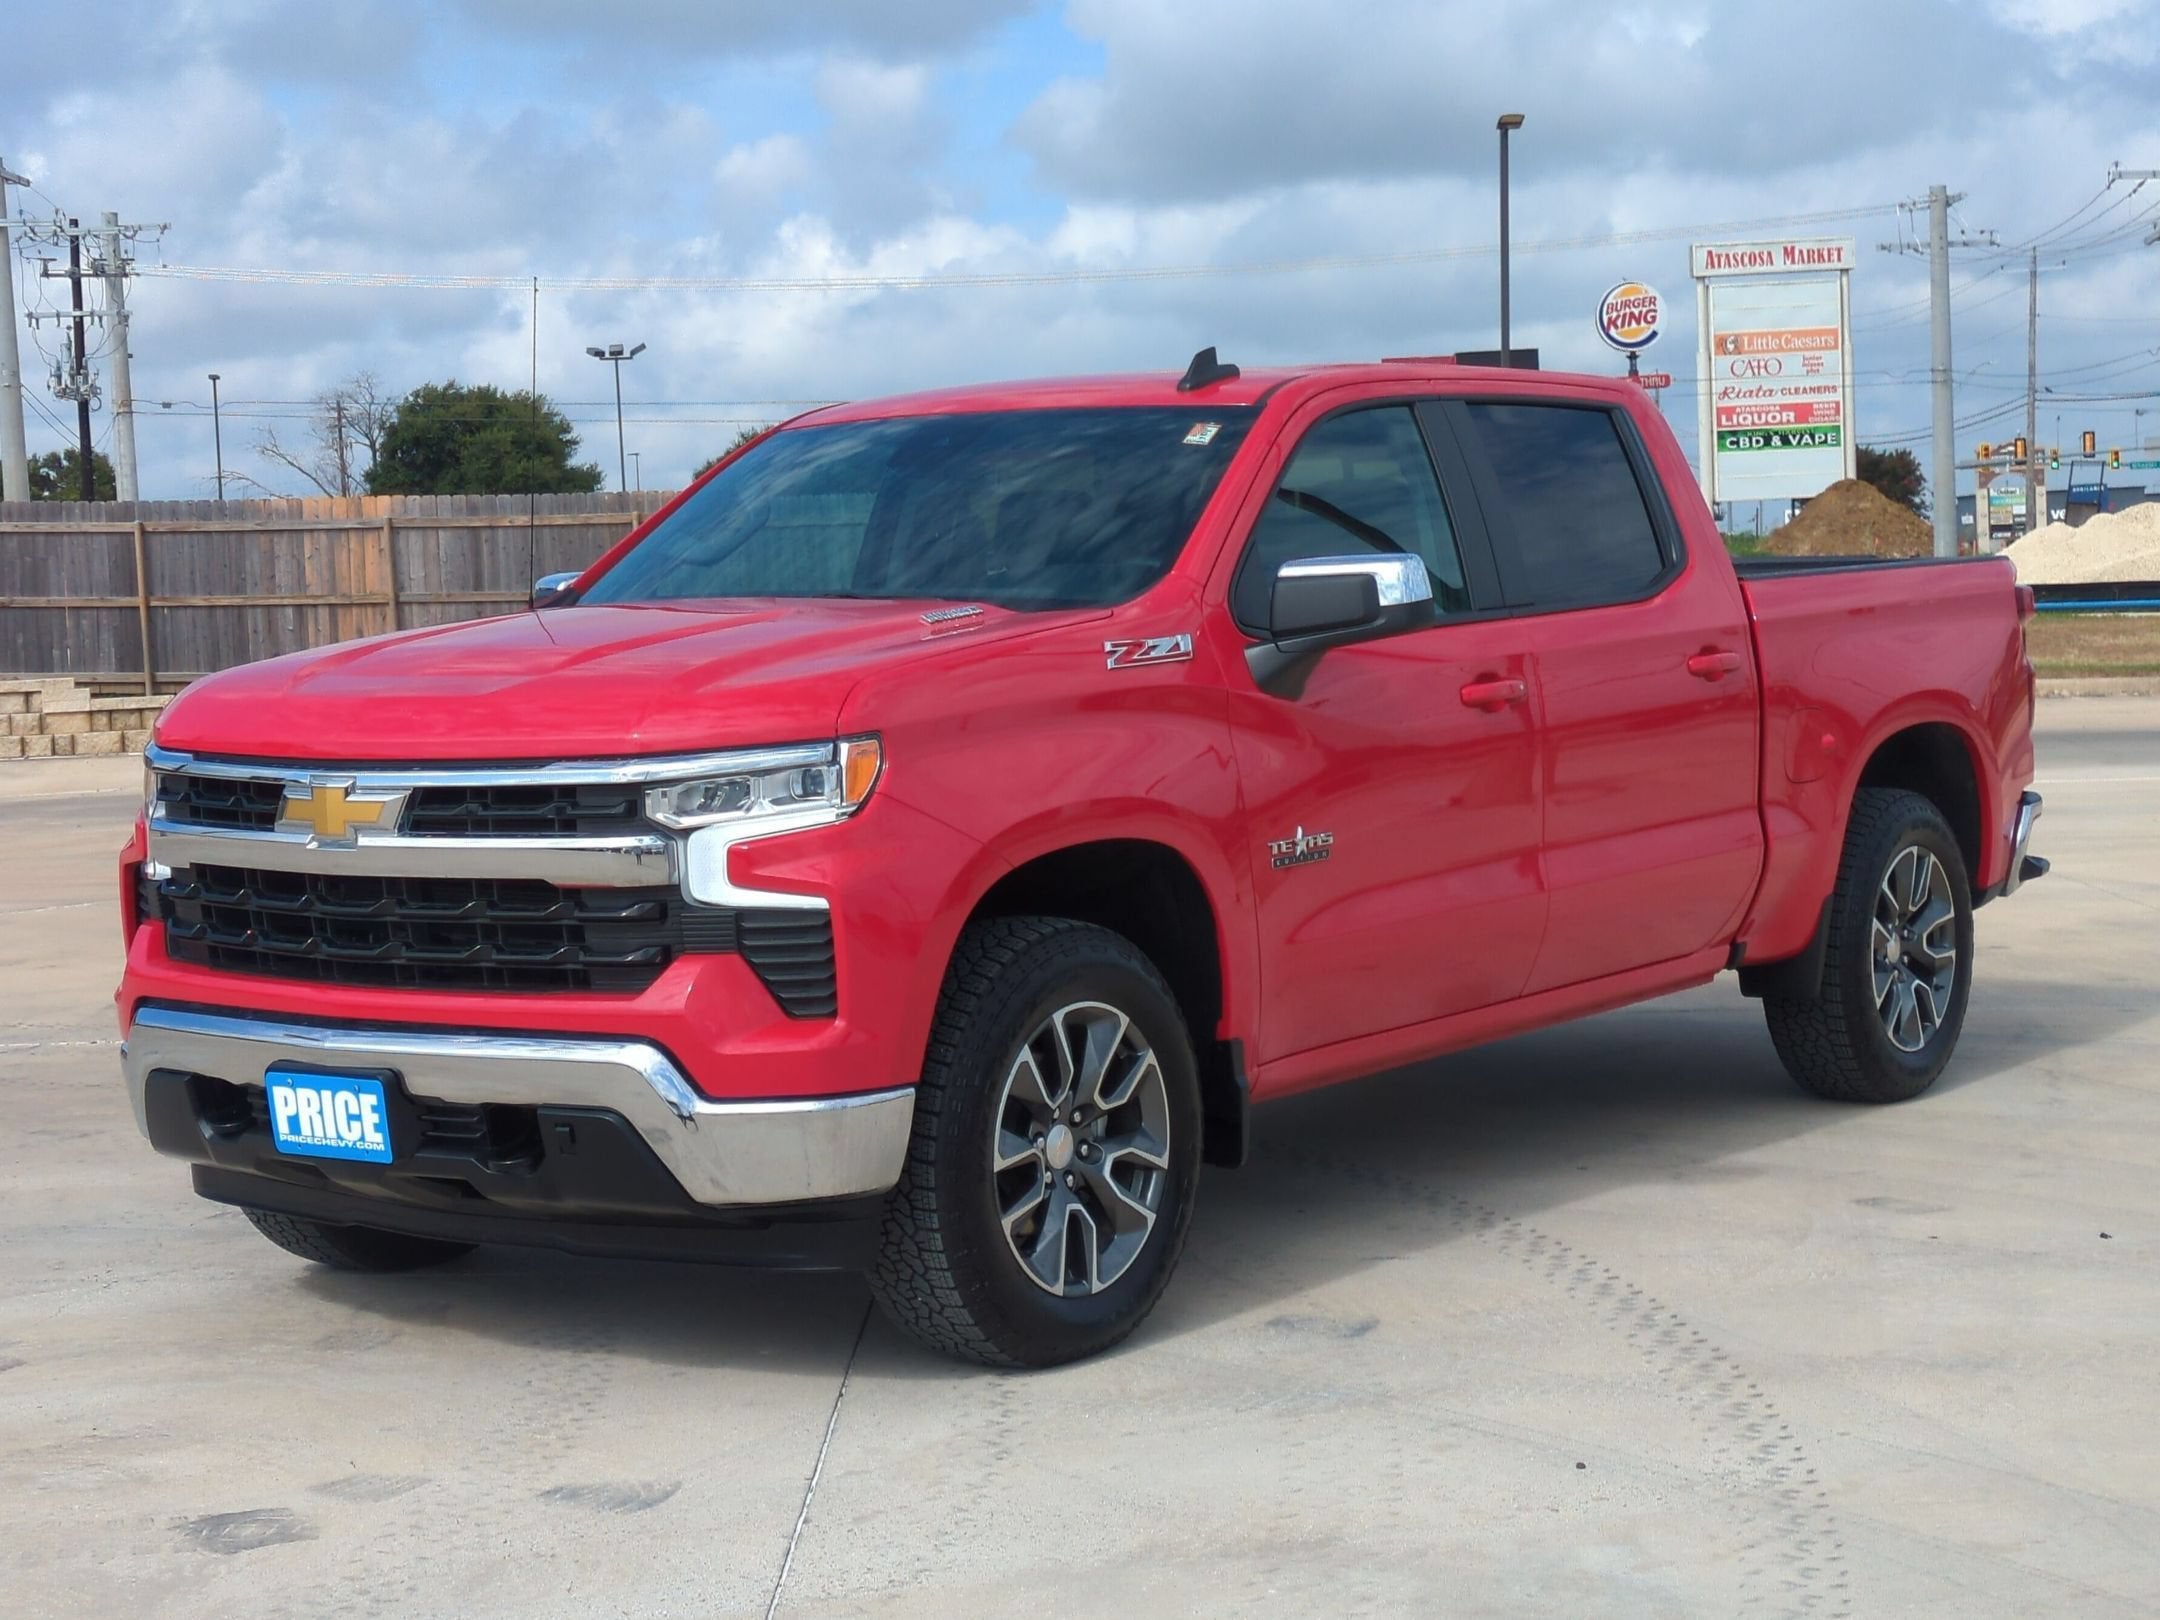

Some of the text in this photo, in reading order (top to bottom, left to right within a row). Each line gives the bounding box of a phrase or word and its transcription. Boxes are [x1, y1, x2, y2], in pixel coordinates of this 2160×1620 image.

[1705, 245, 1843, 270] ATASCOSA MARKET
[1606, 296, 1657, 315] BURGER
[1606, 309, 1658, 333] KING
[1743, 333, 1834, 350] Little Caesars
[1730, 357, 1782, 377] CATO
[1640, 376, 1665, 386] THRU
[1718, 384, 1838, 400] Riata CLEANERS
[1735, 405, 1780, 413] ATASCOSA
[1721, 411, 1795, 426] LIQUOR
[1726, 433, 1837, 449] CBD & VAPE
[1104, 633, 1193, 671] Z71
[1267, 826, 1334, 856] TEXAS
[272, 1085, 384, 1143] PRICE
[280, 1134, 385, 1151] PRICECHEVY.COM
